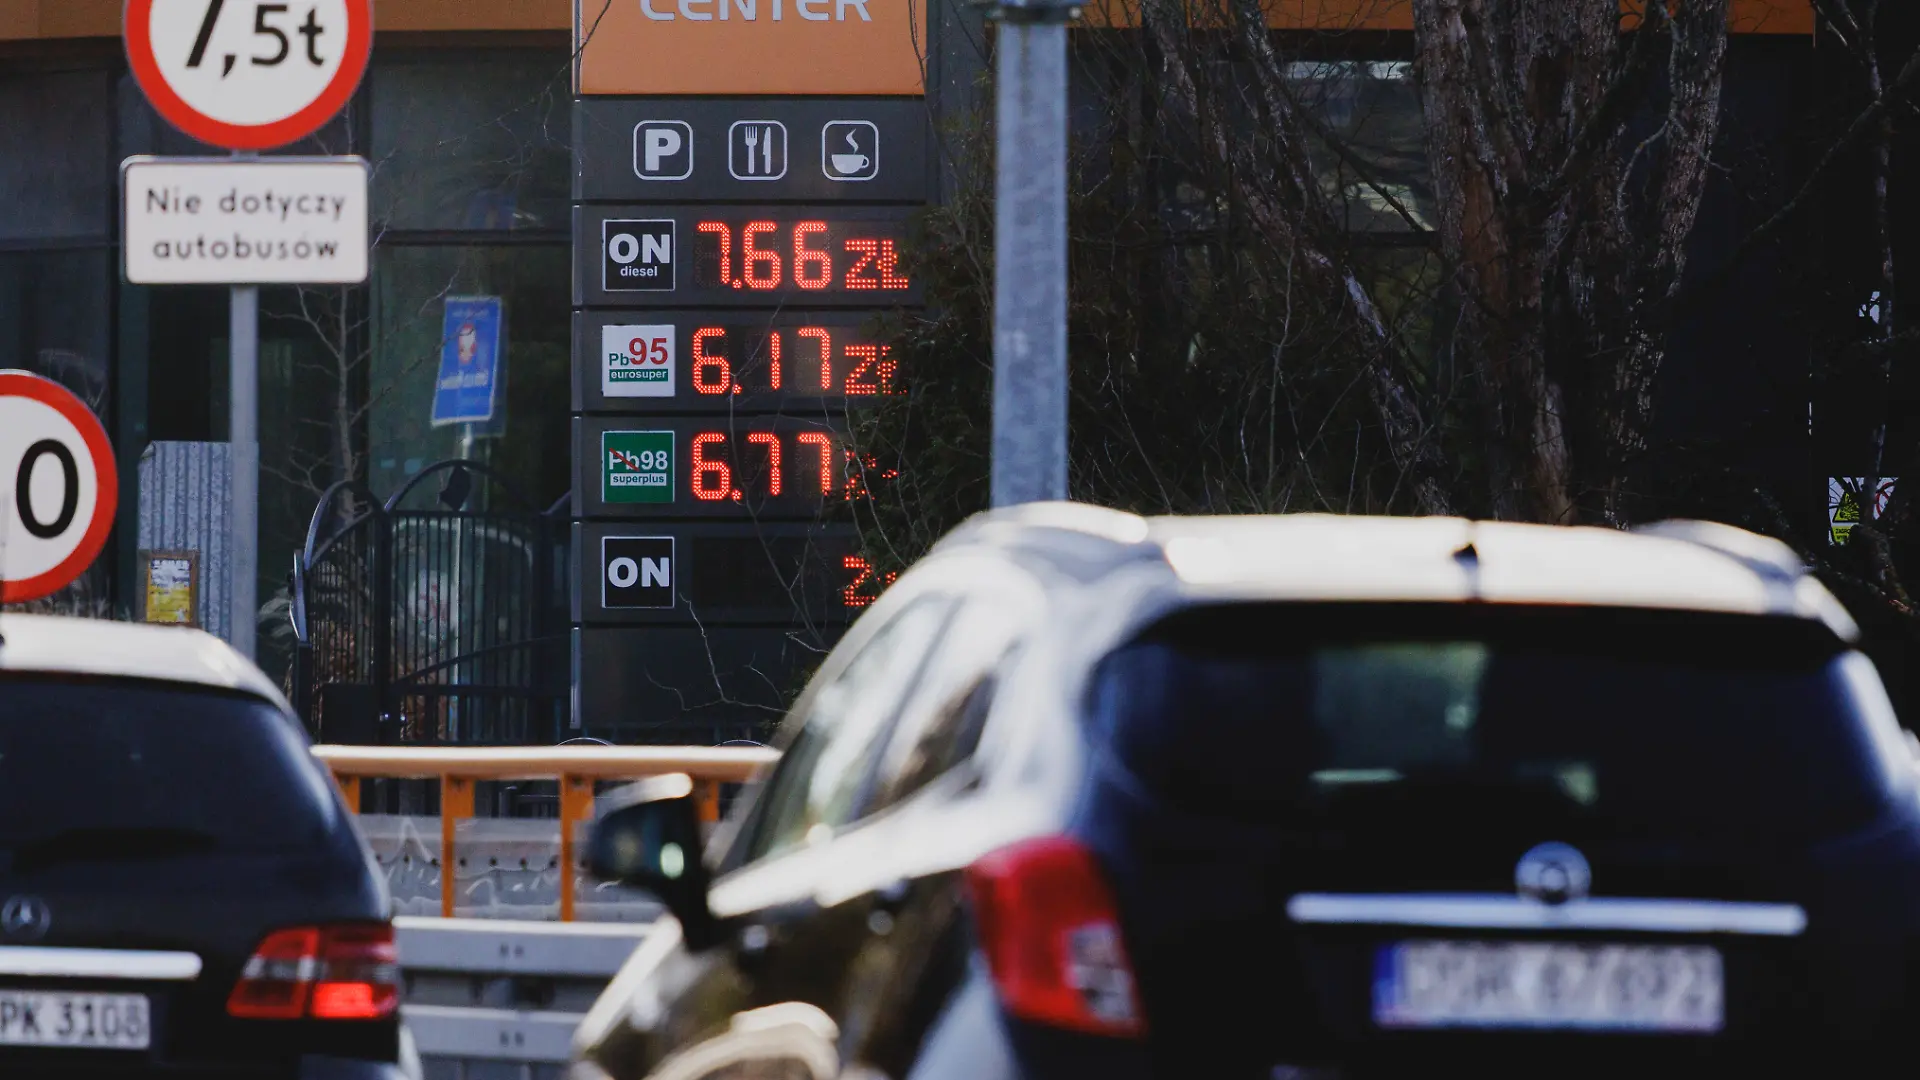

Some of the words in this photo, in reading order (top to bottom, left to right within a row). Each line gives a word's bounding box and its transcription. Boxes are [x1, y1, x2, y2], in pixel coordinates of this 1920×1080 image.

[146, 187, 201, 214] Nie
[218, 188, 344, 222] dotyczy
[152, 233, 338, 260] autobusów
[609, 233, 670, 263] ON
[698, 221, 832, 289] 7.66
[620, 266, 658, 277] diesel
[611, 371, 667, 380] eurosuper
[693, 327, 831, 394] 6.17
[609, 450, 668, 470] Pb98
[692, 433, 832, 500] 6.77
[612, 474, 665, 484] superplus
[608, 557, 670, 588] ON
